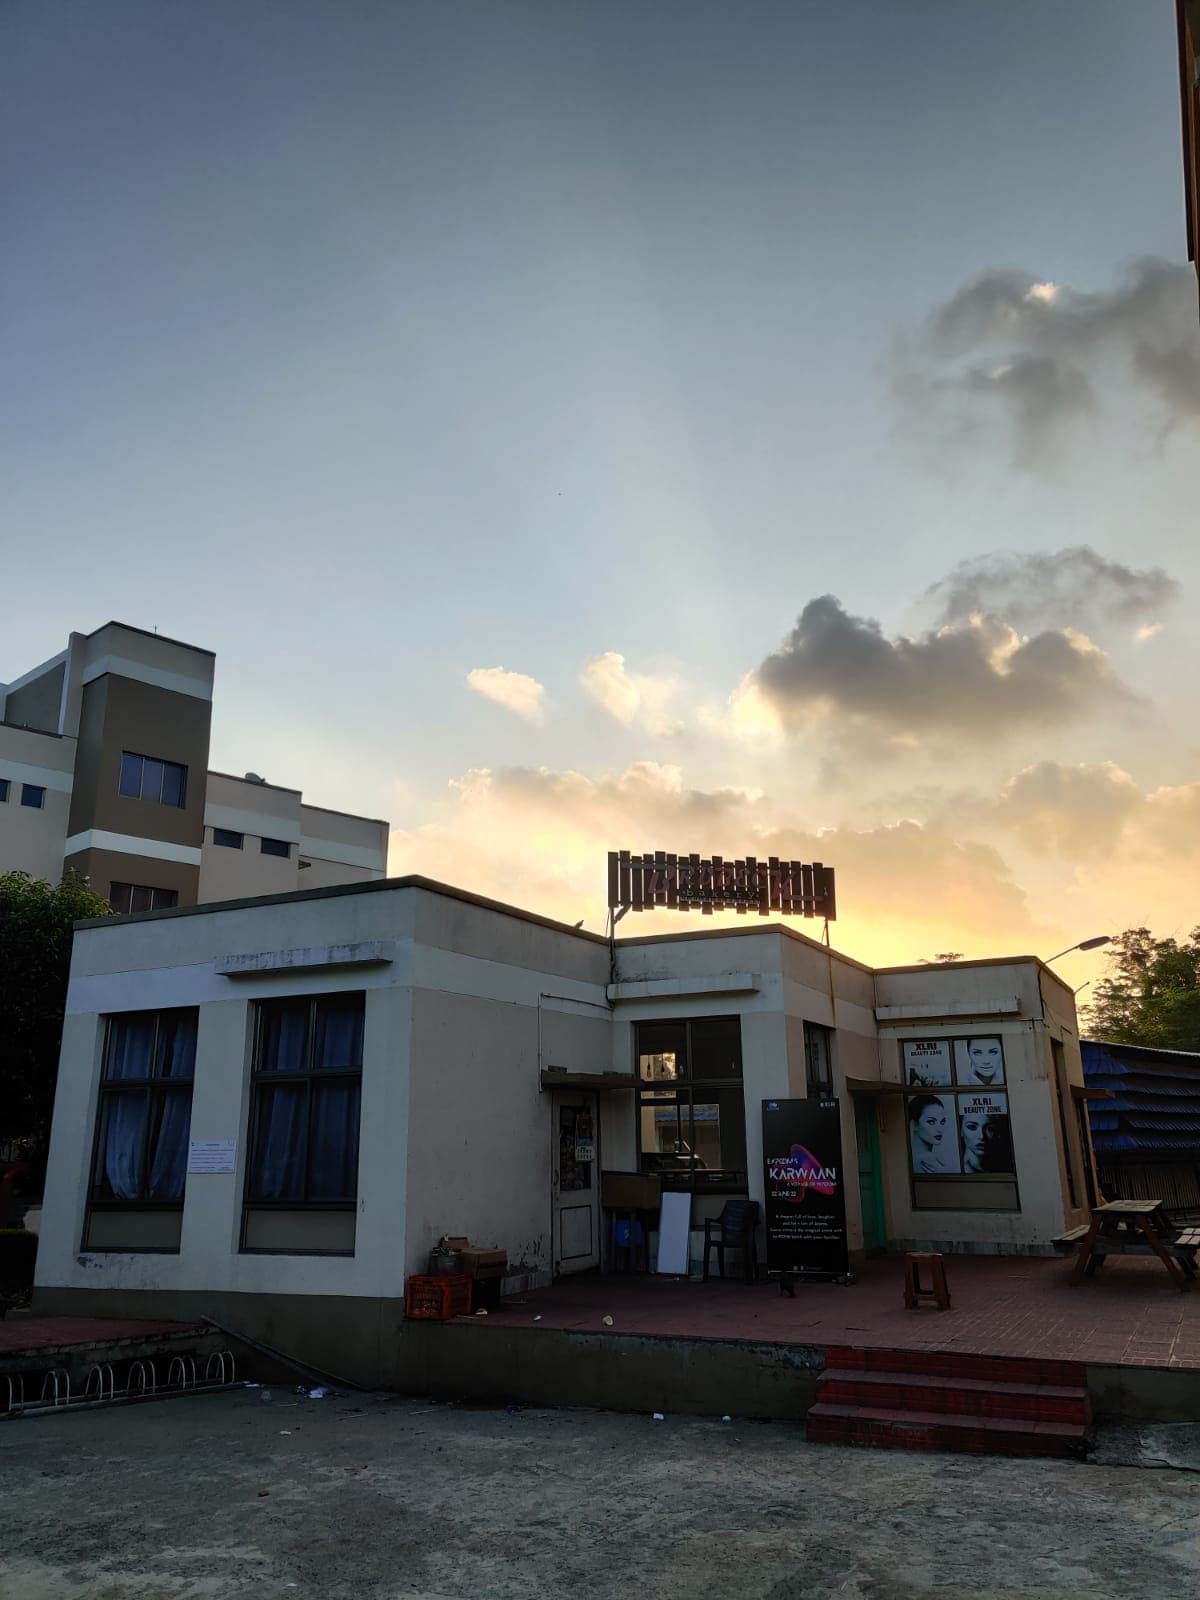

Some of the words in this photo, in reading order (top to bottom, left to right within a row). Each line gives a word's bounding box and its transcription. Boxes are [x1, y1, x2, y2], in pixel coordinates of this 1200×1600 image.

[686, 889, 755, 898] bakery
[915, 1042, 937, 1050] XLRI
[972, 1098, 992, 1106] XLRI
[964, 1106, 985, 1114] BEAUTY
[769, 1167, 836, 1180] KARWAAN
